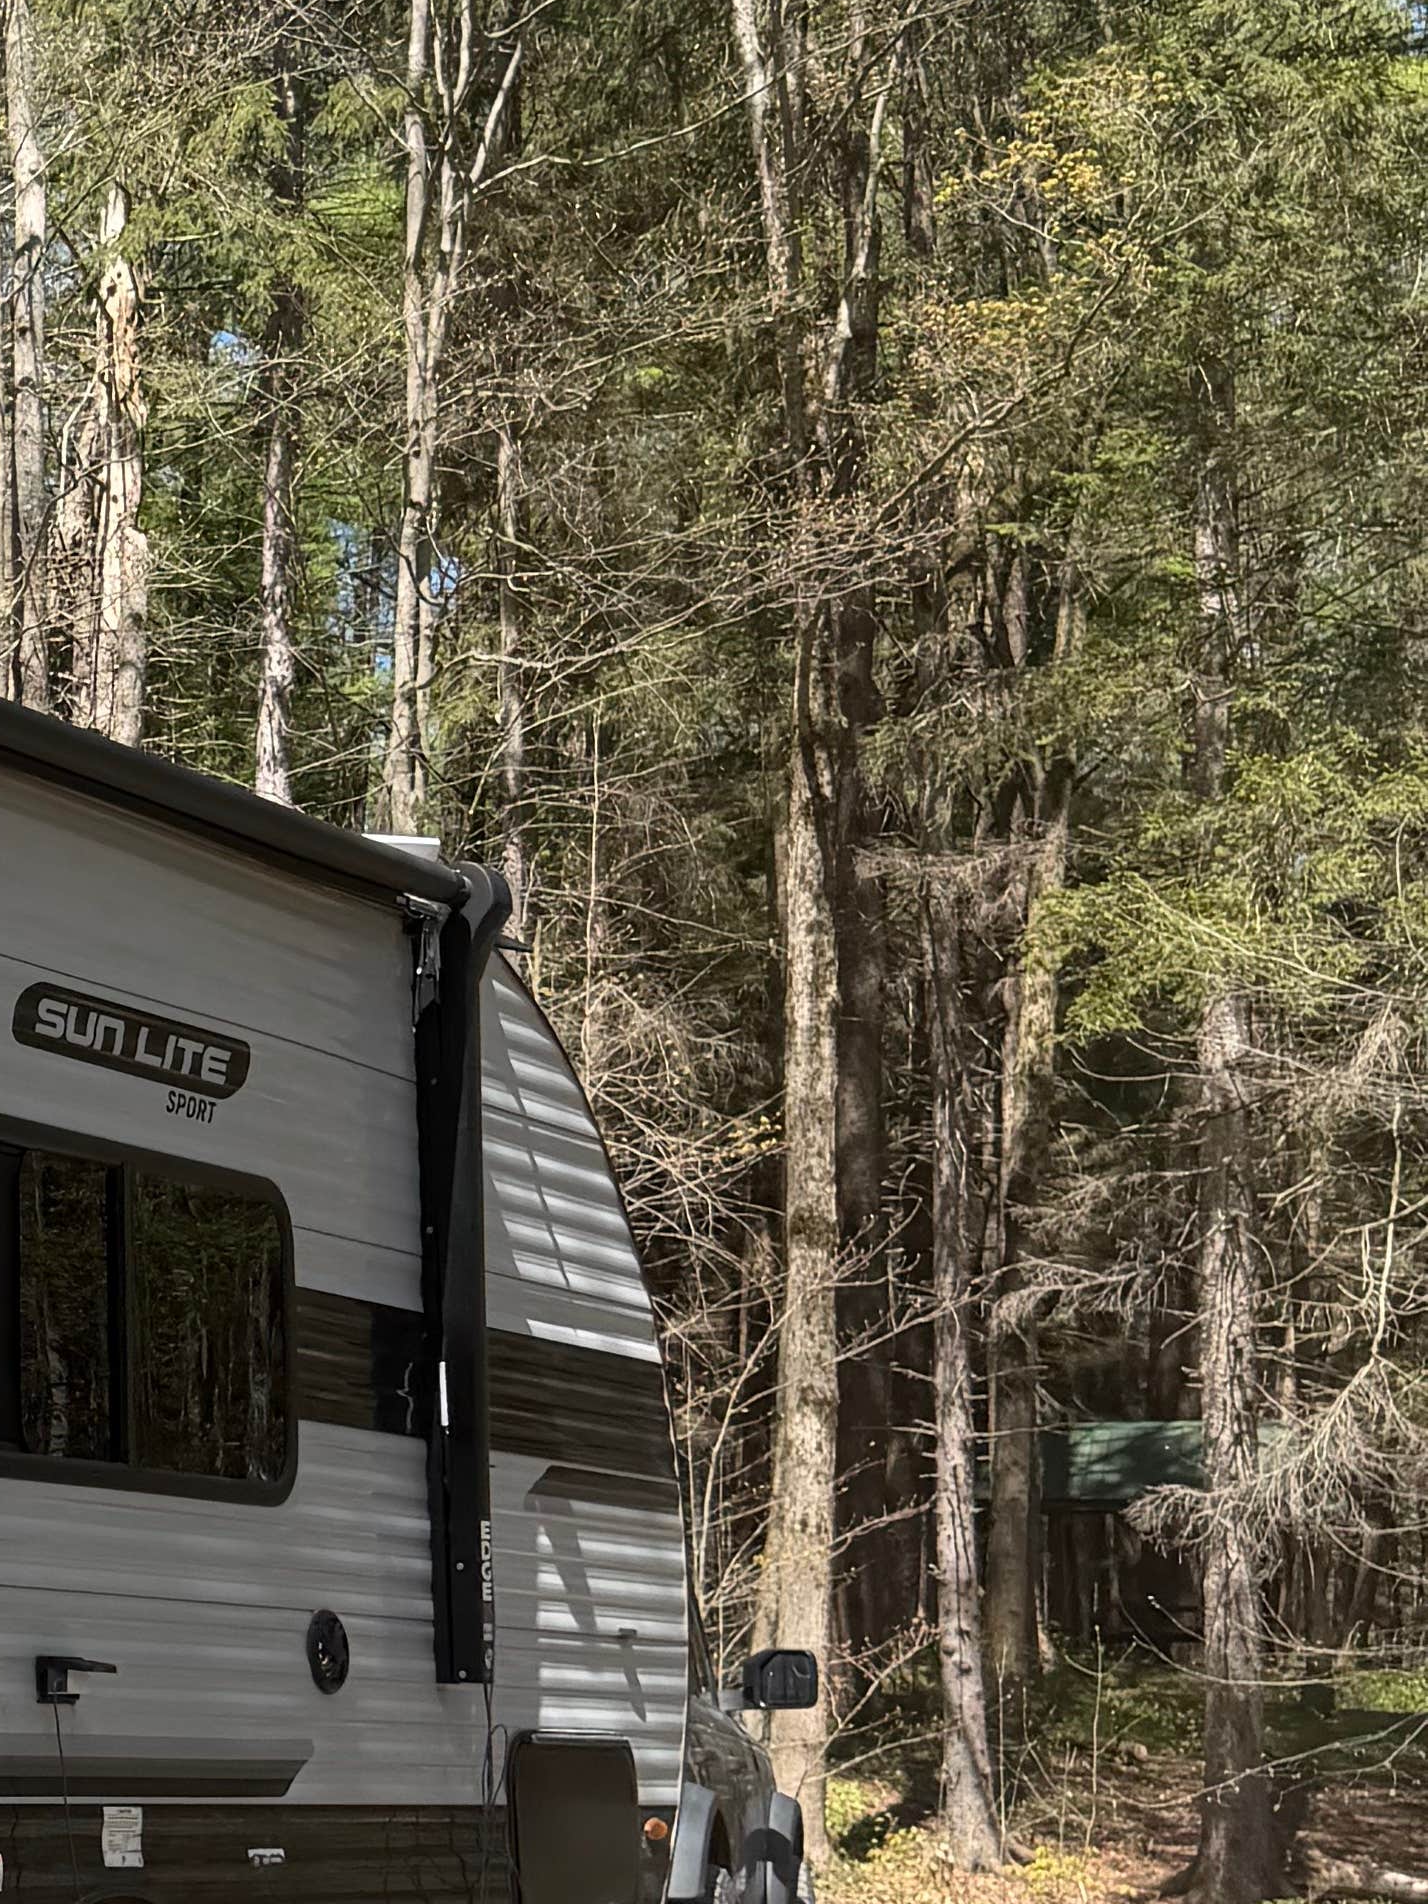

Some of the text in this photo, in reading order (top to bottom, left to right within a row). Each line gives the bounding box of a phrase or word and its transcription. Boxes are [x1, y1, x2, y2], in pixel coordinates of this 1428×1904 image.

[35, 997, 232, 1086] SUN LITE
[166, 1090, 217, 1124] SPORT
[480, 1520, 493, 1602] EDGE
